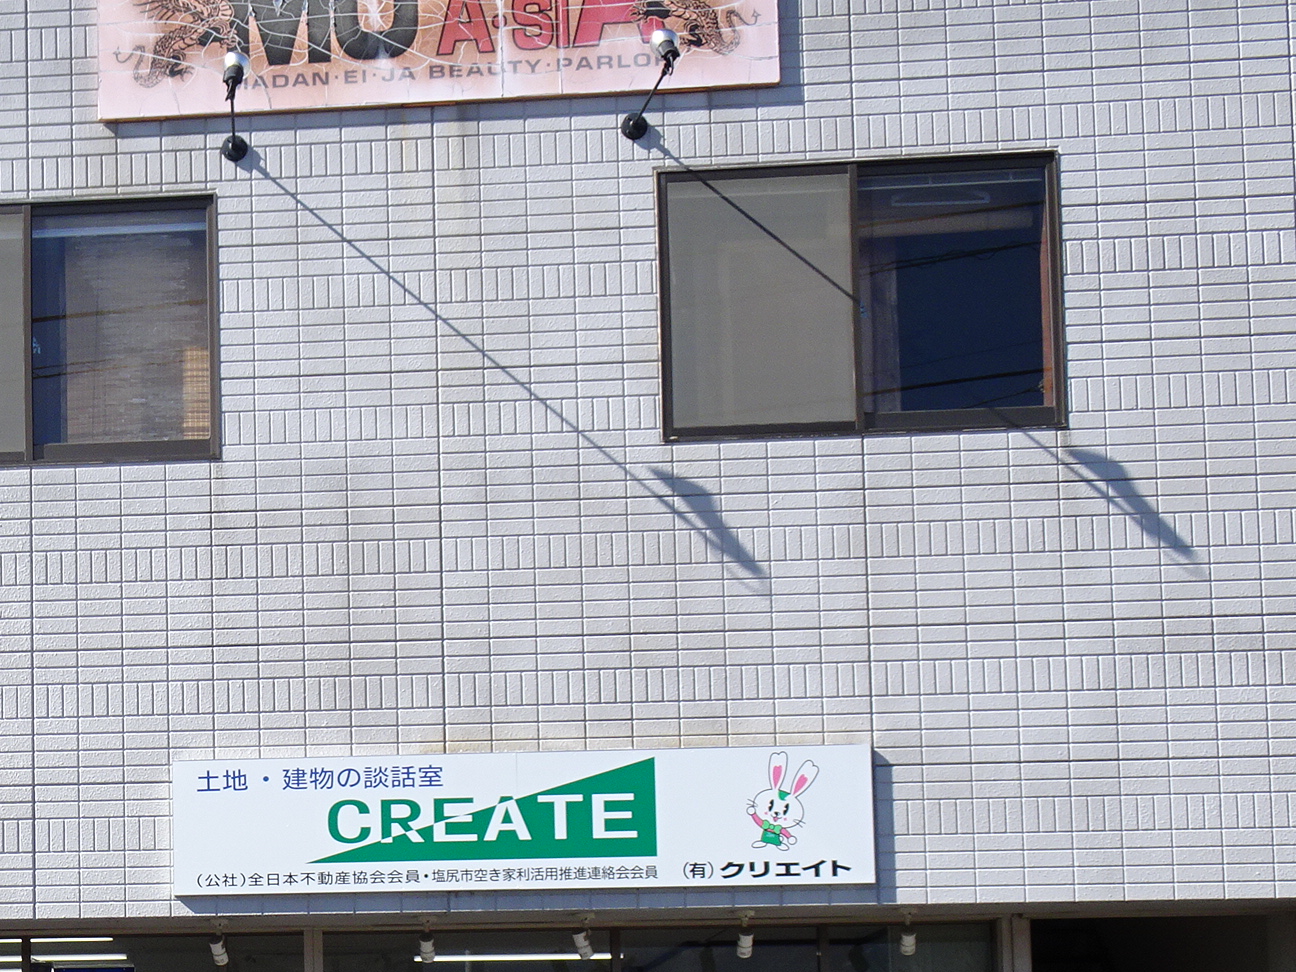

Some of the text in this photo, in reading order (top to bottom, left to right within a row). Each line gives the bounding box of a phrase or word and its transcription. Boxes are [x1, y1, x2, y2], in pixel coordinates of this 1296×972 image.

[195, 763, 445, 793] 土地・建物の談話室
[326, 792, 640, 845] CREATE
